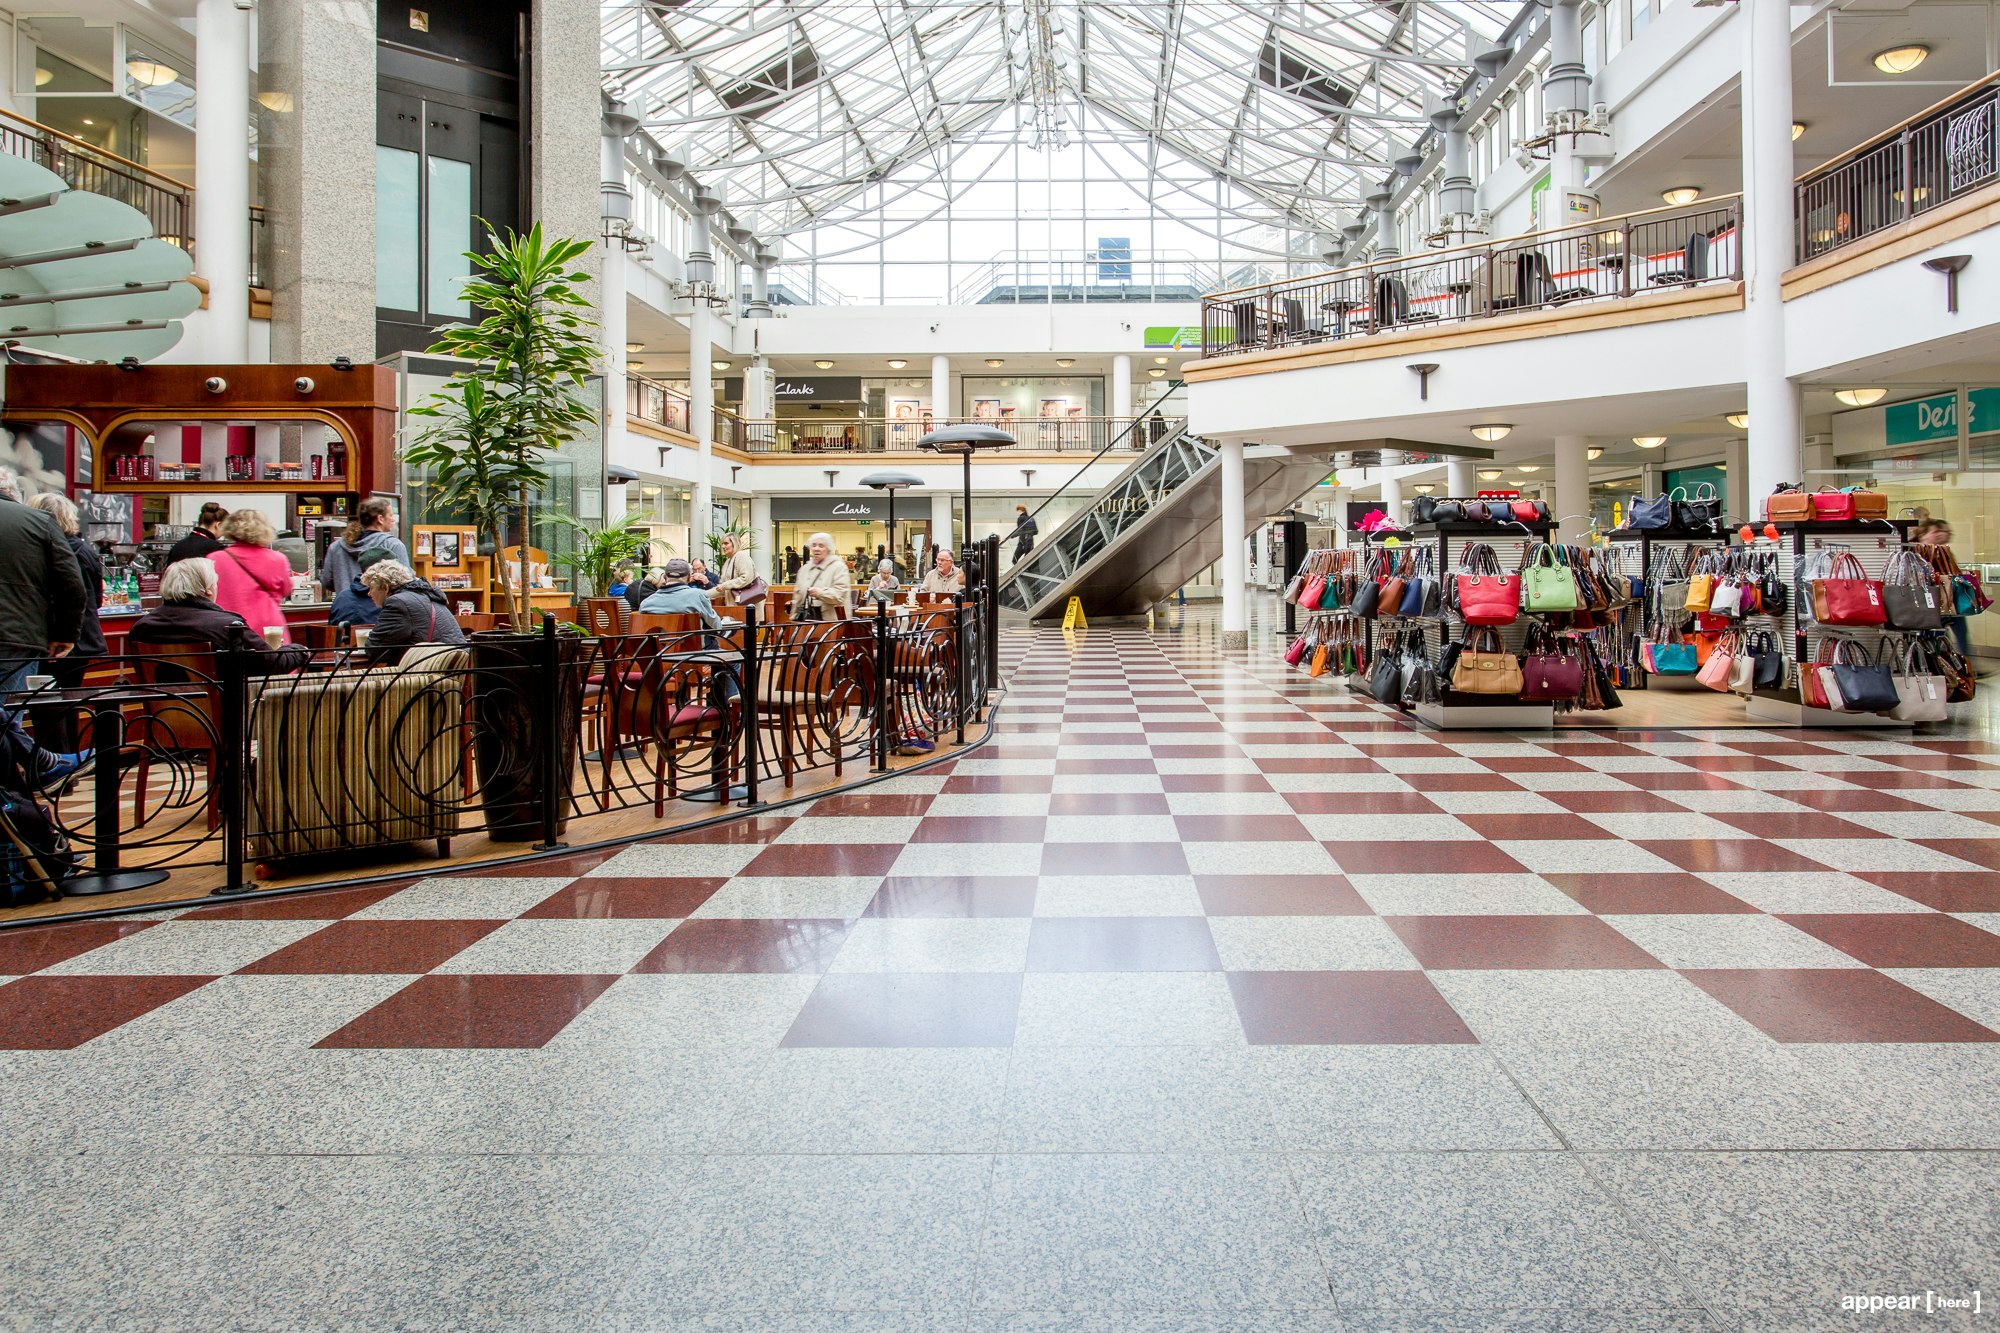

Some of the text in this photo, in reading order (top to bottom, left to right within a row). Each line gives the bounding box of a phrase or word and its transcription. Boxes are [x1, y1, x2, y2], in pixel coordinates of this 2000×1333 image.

[1570, 201, 1589, 209] Cetrum
[775, 383, 814, 395] Clarks
[1919, 396, 1976, 430] Desie
[1896, 460, 1913, 470] SALE
[832, 503, 871, 515] Clarks
